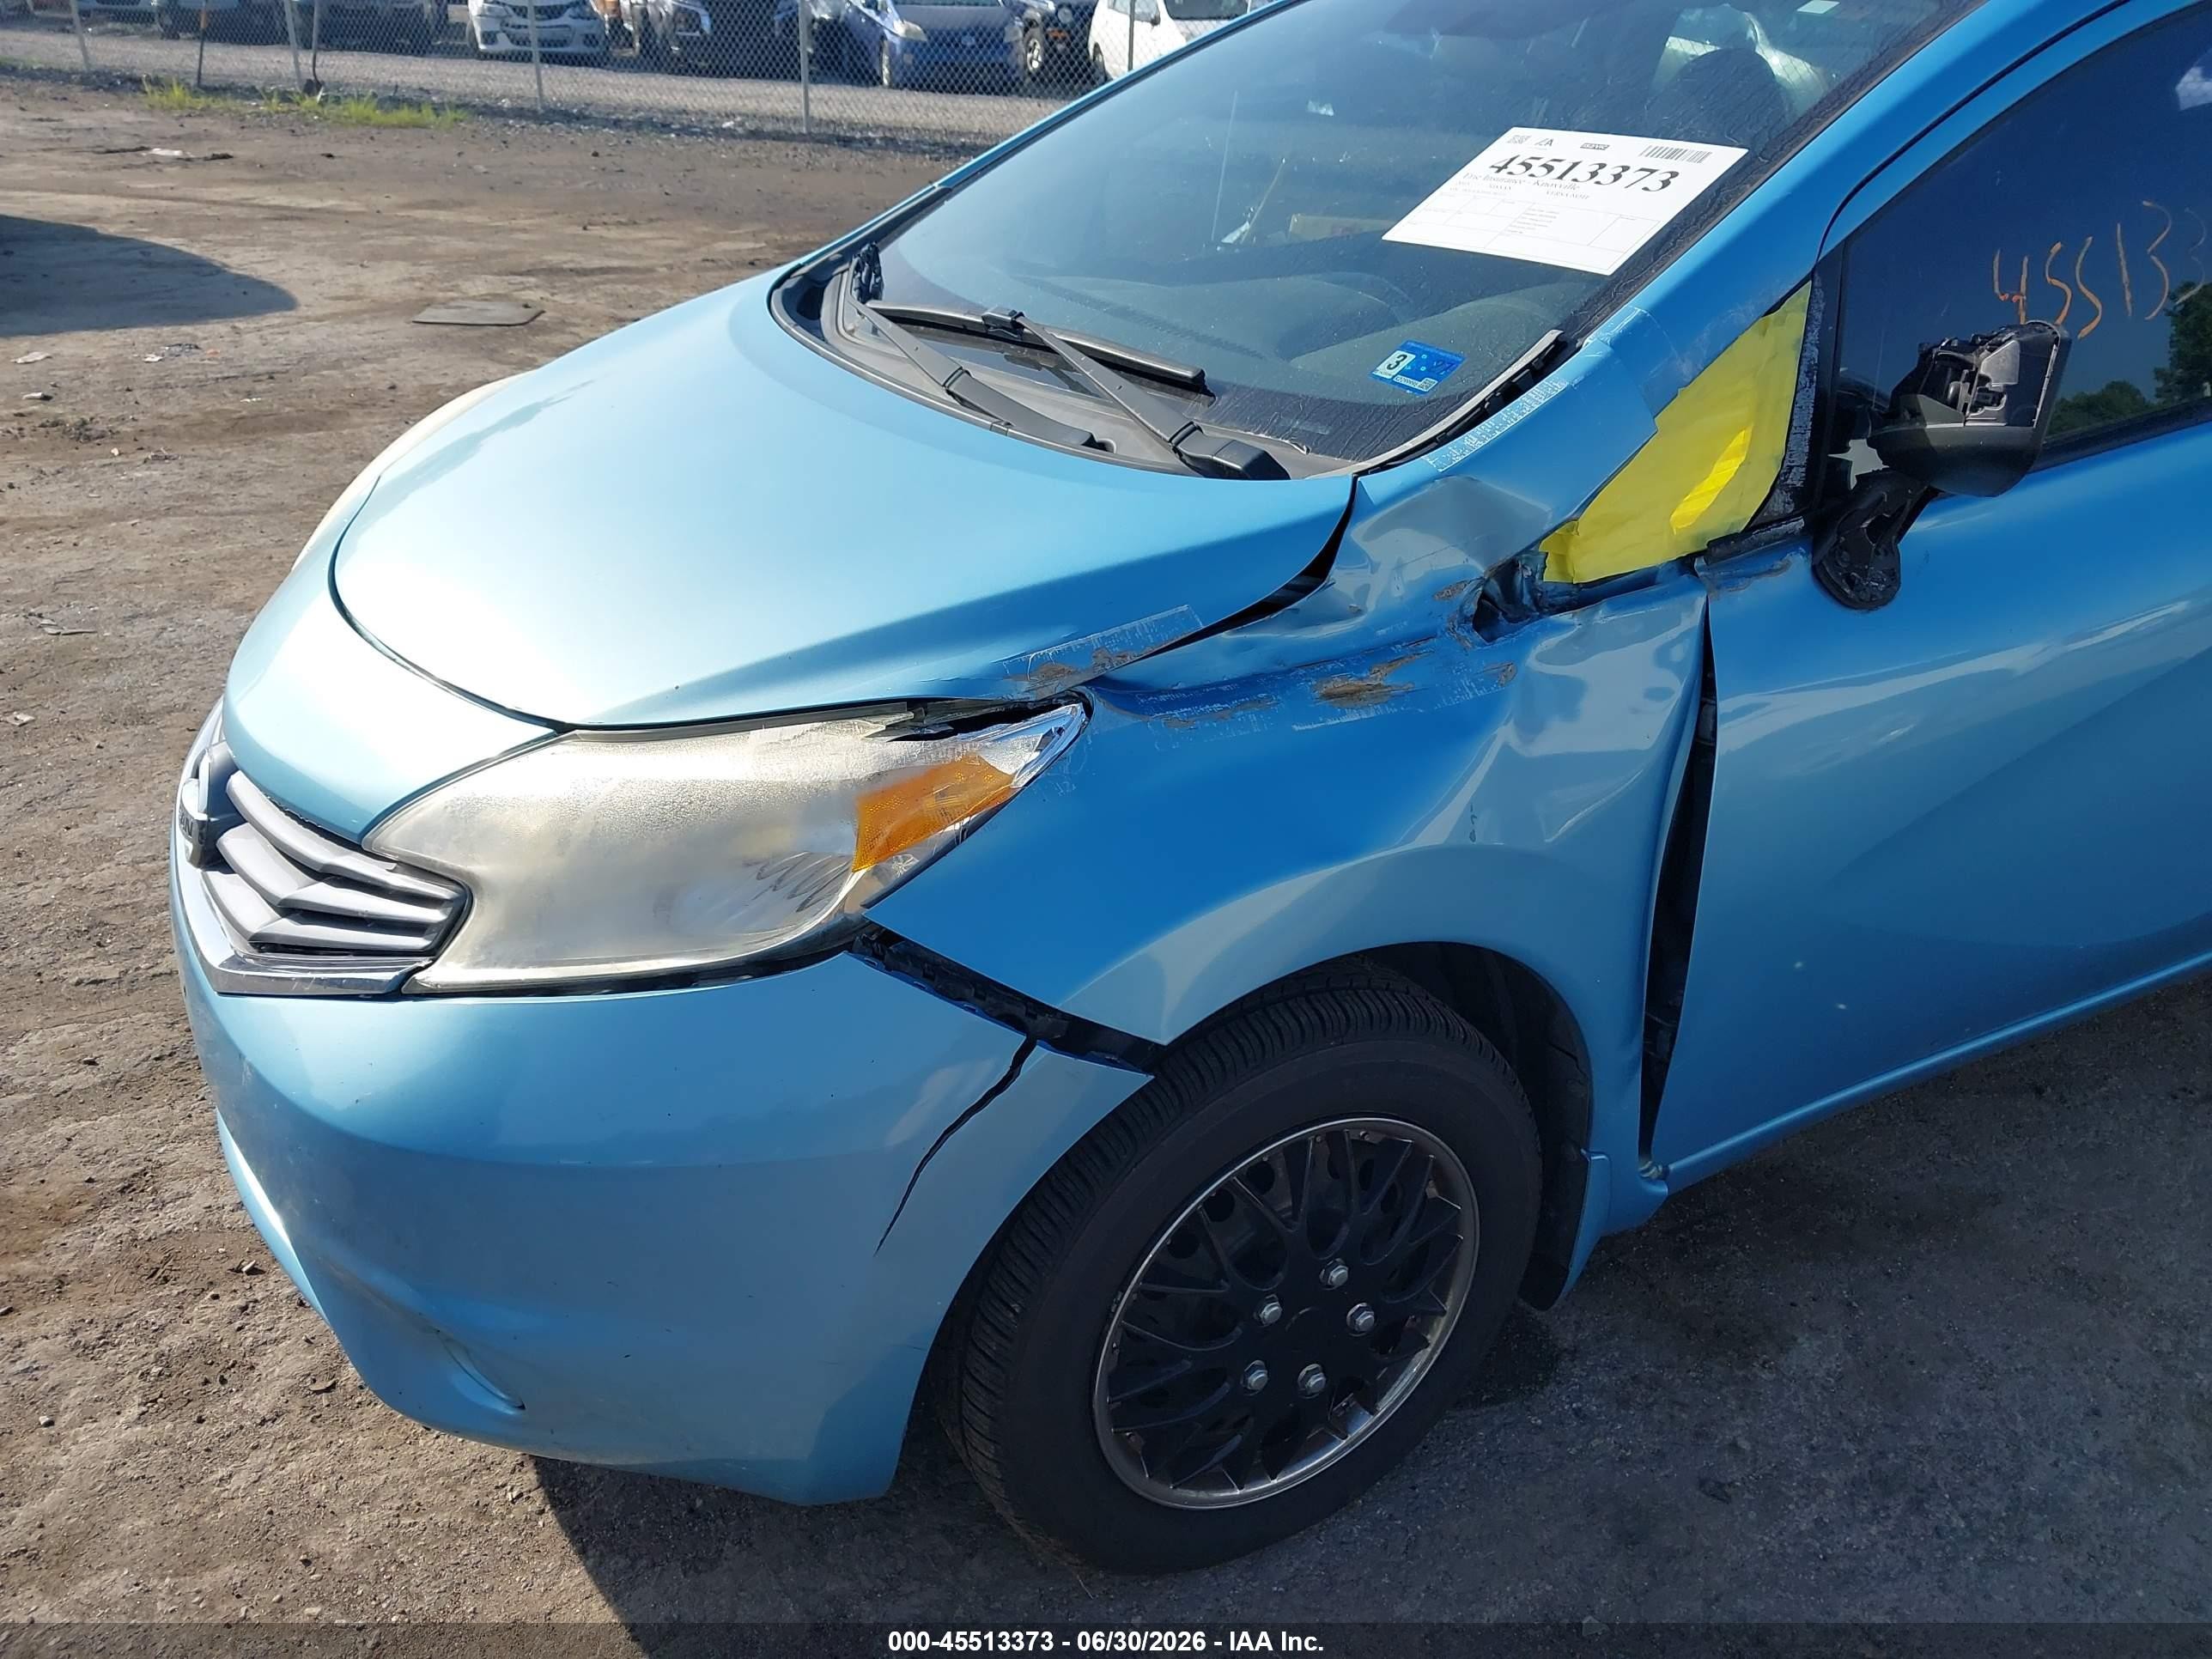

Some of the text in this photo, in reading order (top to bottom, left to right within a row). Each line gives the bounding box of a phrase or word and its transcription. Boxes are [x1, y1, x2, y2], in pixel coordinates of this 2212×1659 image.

[1489, 155, 1680, 192] 45513373
[1533, 178, 1581, 191] Knoxville
[1386, 354, 1408, 372] 3
